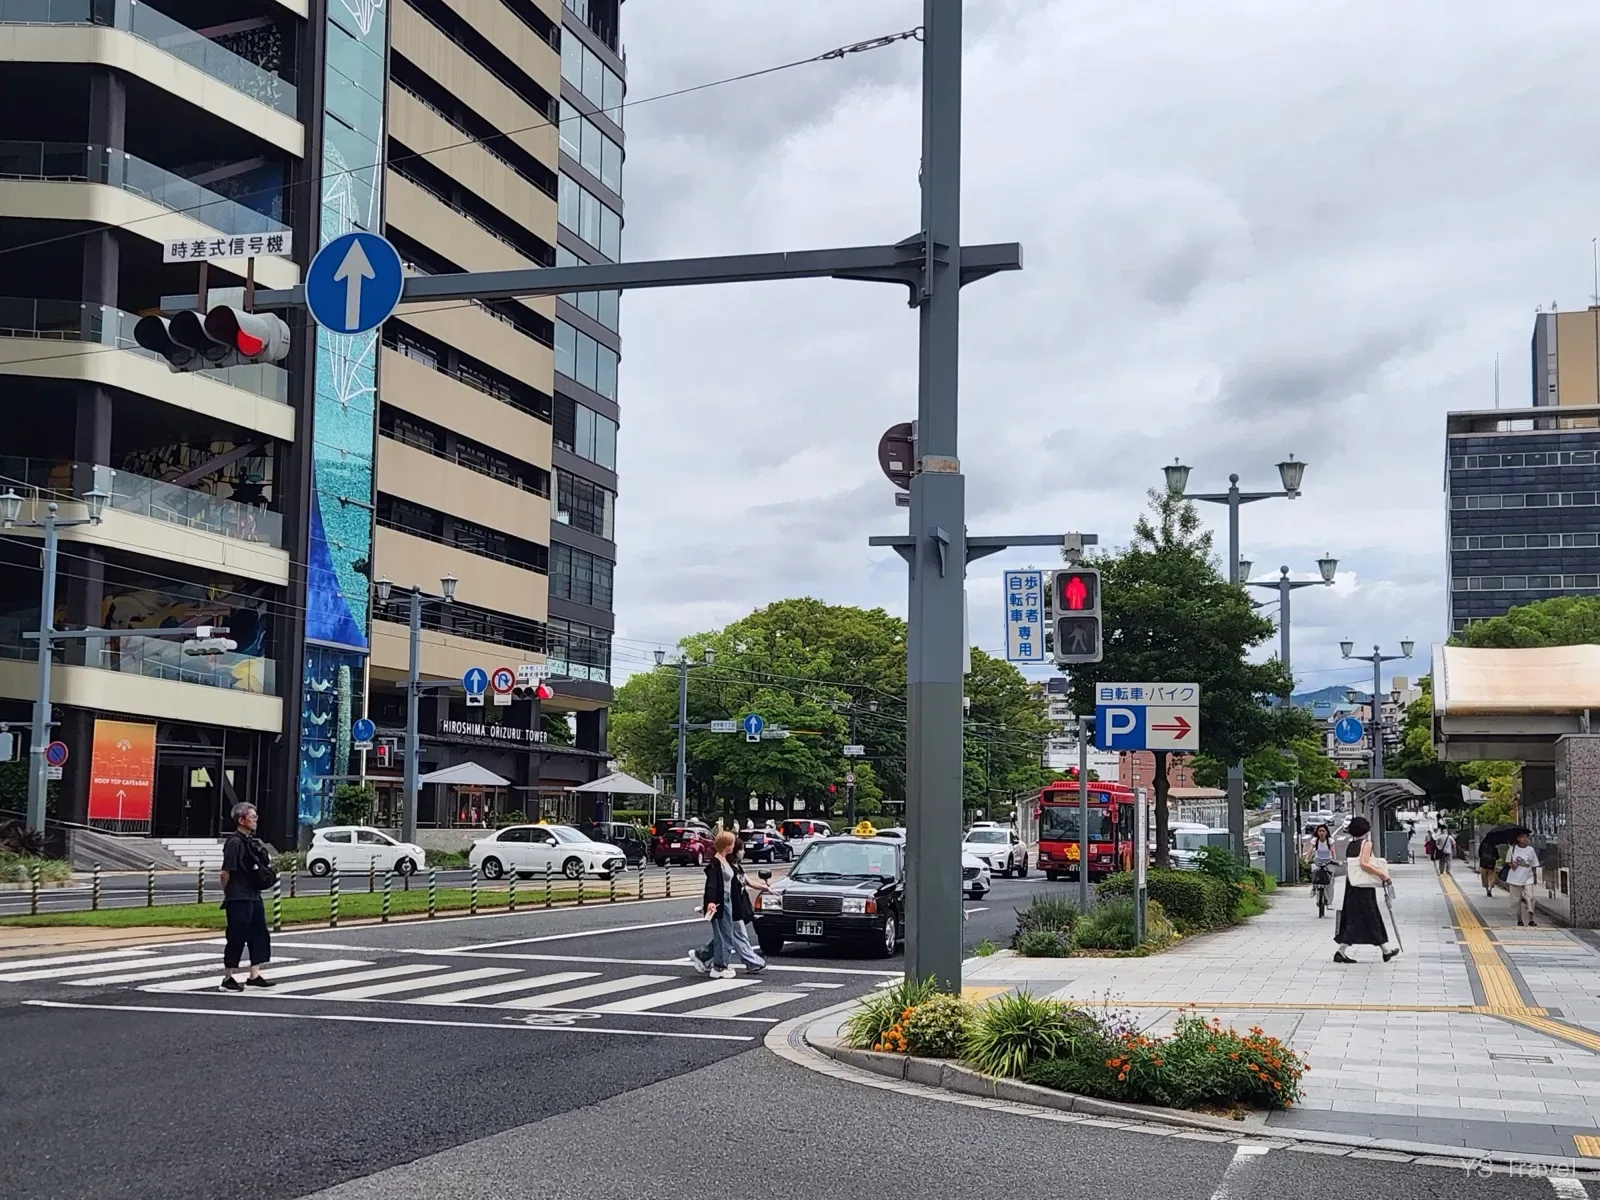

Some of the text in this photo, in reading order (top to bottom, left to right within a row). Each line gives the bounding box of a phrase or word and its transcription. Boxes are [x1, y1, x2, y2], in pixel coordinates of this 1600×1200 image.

[171, 234, 284, 258] 時差式信号機
[1009, 576, 1024, 623] 自転車
[1024, 576, 1038, 623] 歩行者
[1018, 626, 1032, 657] 専用
[443, 719, 548, 743] HIROSHIMA ORIZURU TOWER
[1105, 708, 1136, 747] P
